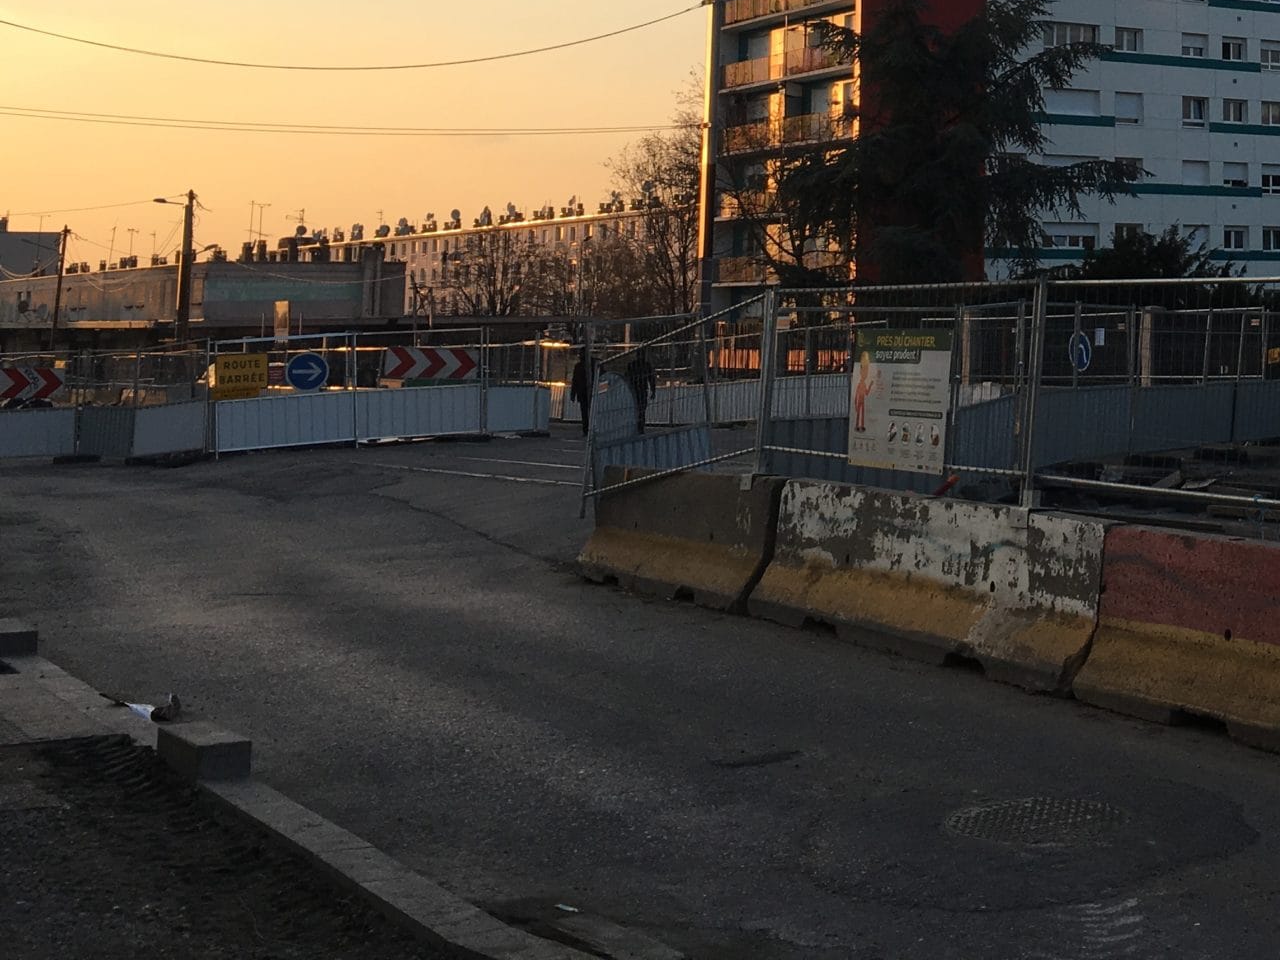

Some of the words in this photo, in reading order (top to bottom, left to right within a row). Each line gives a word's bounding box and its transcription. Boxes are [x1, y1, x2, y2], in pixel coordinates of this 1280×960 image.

[893, 335, 903, 346] DU
[875, 350, 892, 361] soyez
[893, 349, 915, 361] prudent
[223, 360, 260, 370] ROUTE
[219, 373, 265, 385] BARRÉE
